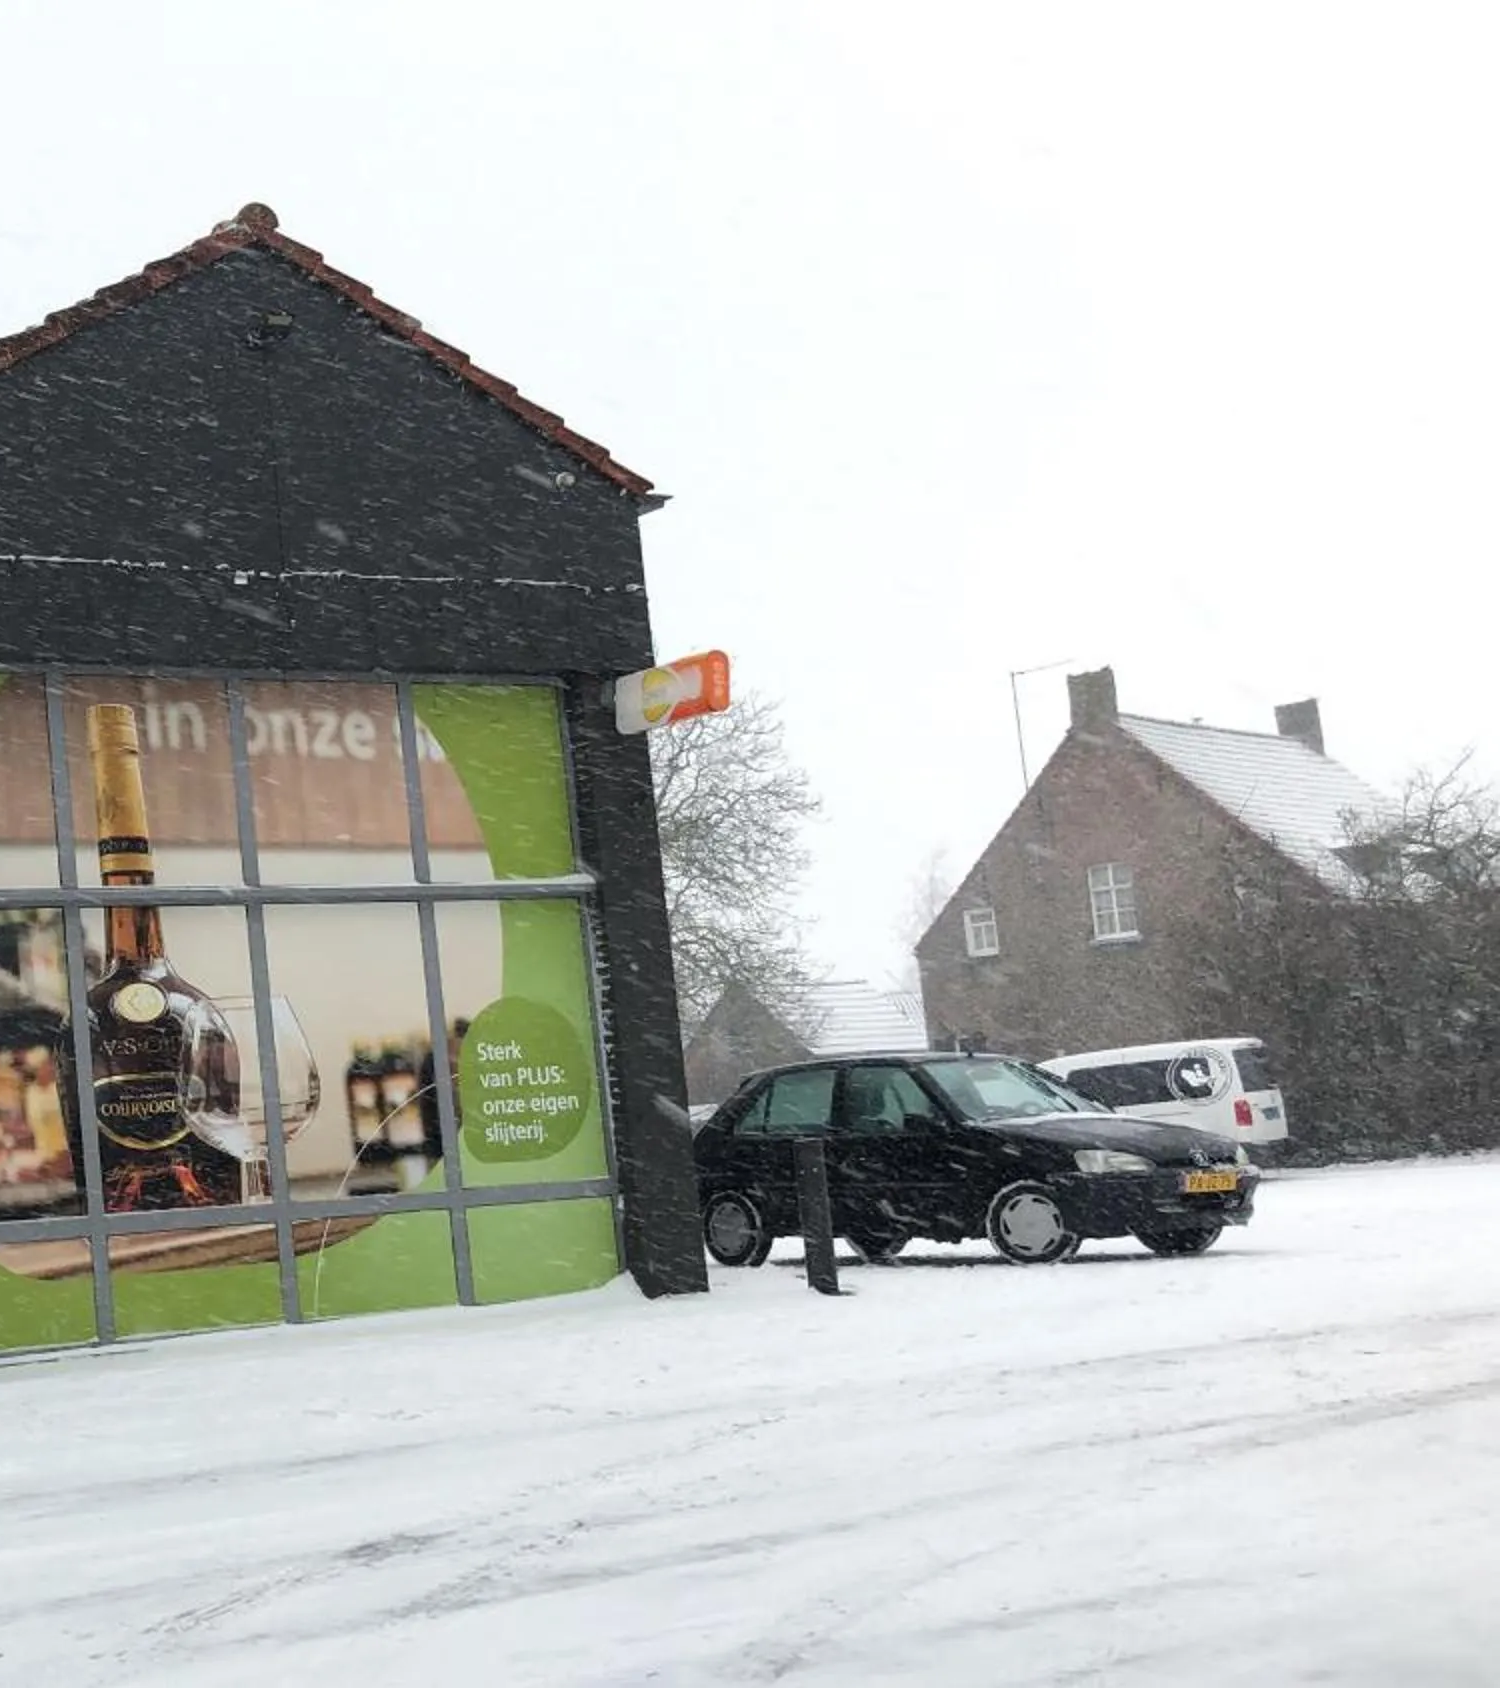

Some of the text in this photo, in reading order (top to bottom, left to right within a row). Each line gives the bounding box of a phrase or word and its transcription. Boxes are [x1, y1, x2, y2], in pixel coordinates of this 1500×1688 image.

[144, 686, 207, 752] in
[477, 1039, 523, 1062] Sterk
[479, 1065, 566, 1088] van PLUS:
[483, 1092, 580, 1115] onze eigen
[484, 1119, 549, 1145] slijterij.
